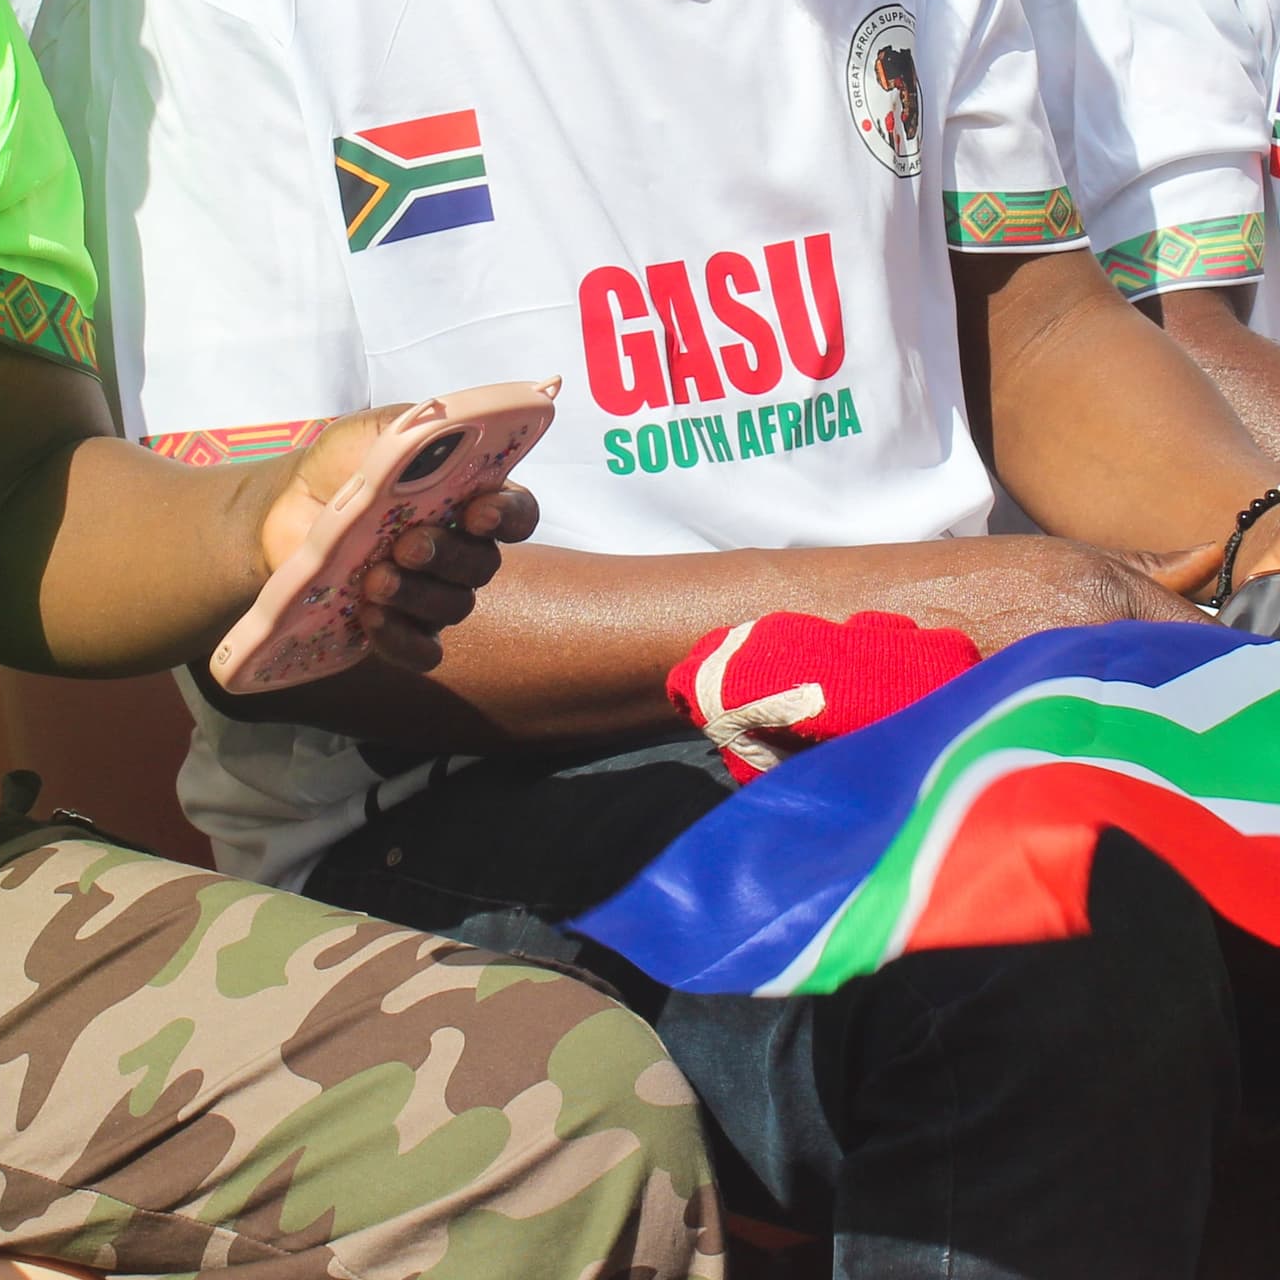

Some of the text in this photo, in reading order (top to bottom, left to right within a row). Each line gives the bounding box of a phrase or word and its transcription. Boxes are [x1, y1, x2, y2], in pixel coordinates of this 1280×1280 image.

[856, 21, 878, 59] AFRICA
[854, 65, 864, 108] GREAT
[578, 232, 846, 417] GASU
[603, 387, 863, 475] SOUTH AFRICA
